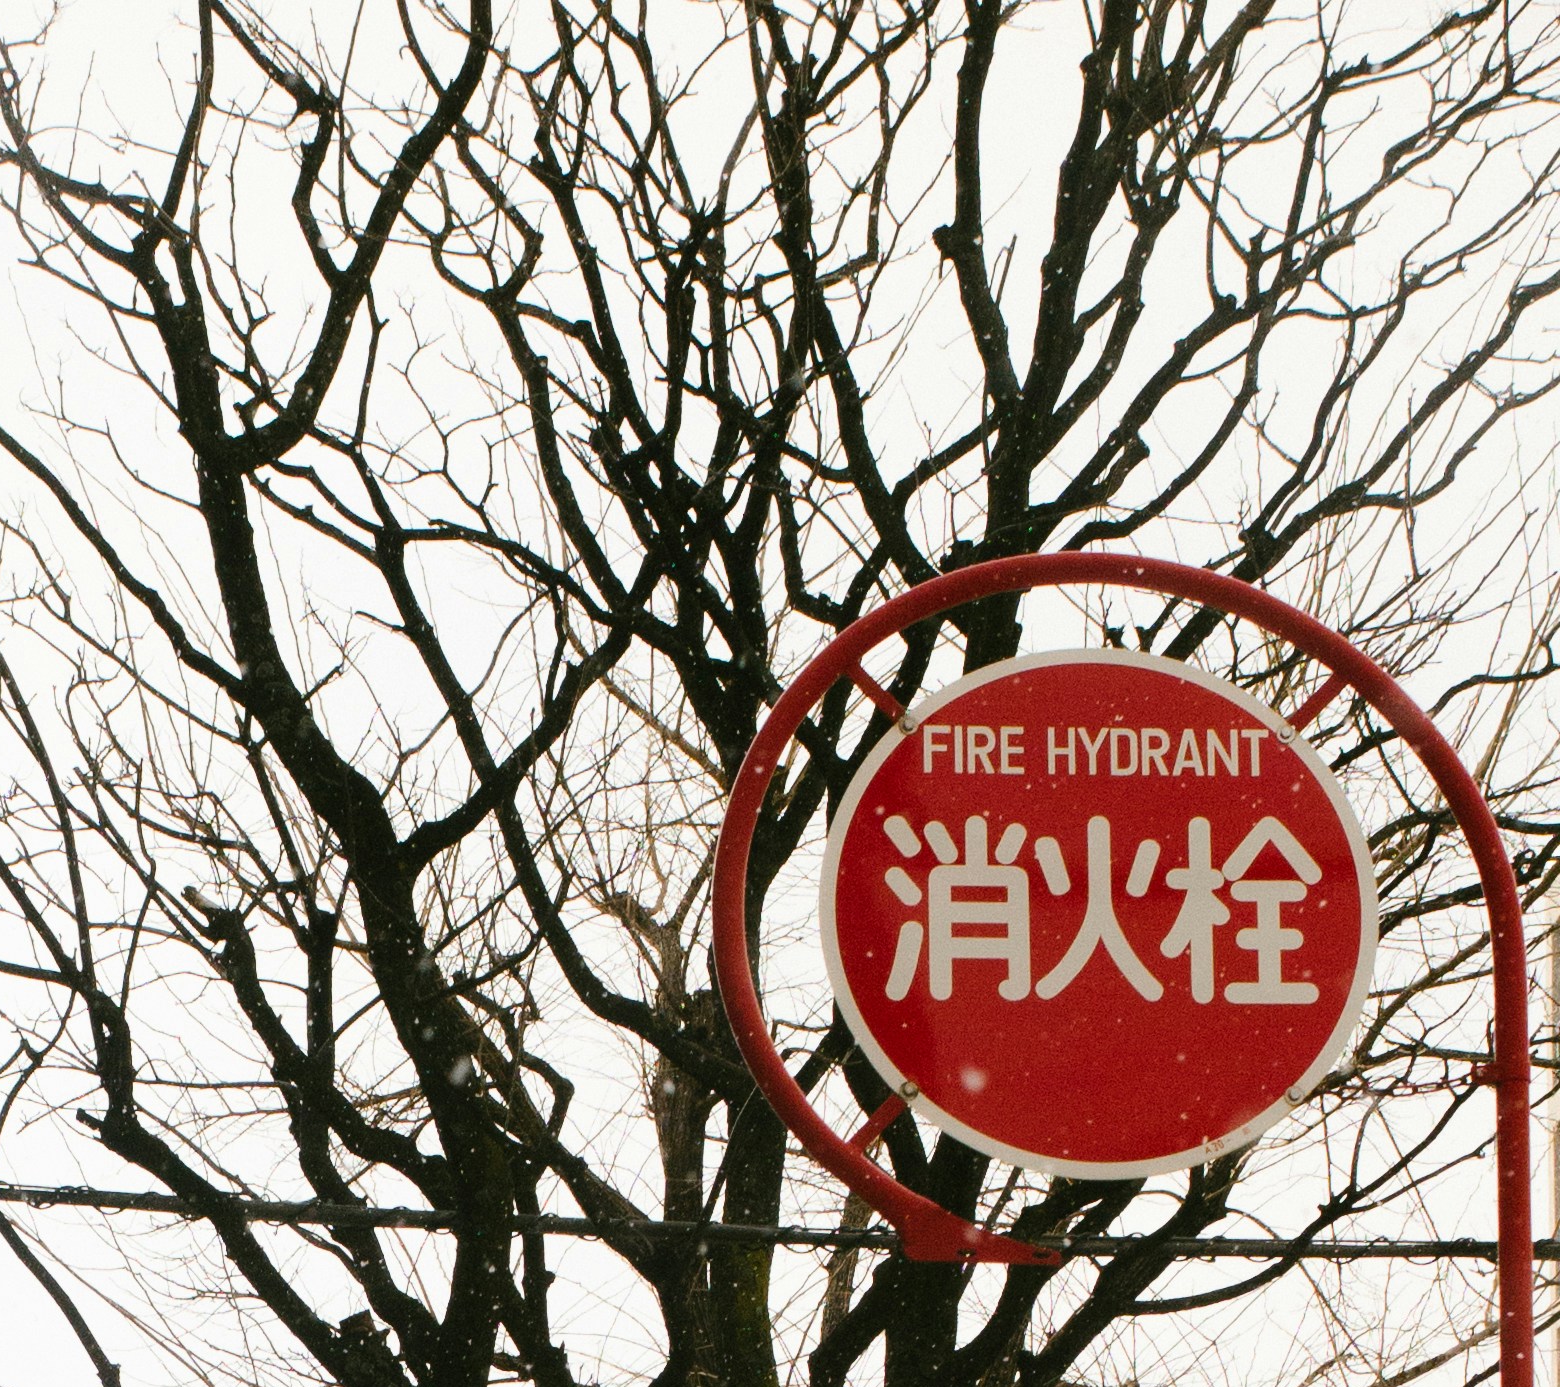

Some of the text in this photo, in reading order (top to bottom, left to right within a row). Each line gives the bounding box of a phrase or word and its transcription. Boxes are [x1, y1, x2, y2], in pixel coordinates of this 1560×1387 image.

[922, 725, 1270, 777] FIRE HYDRANT
[883, 815, 1324, 1005] 消火栓
